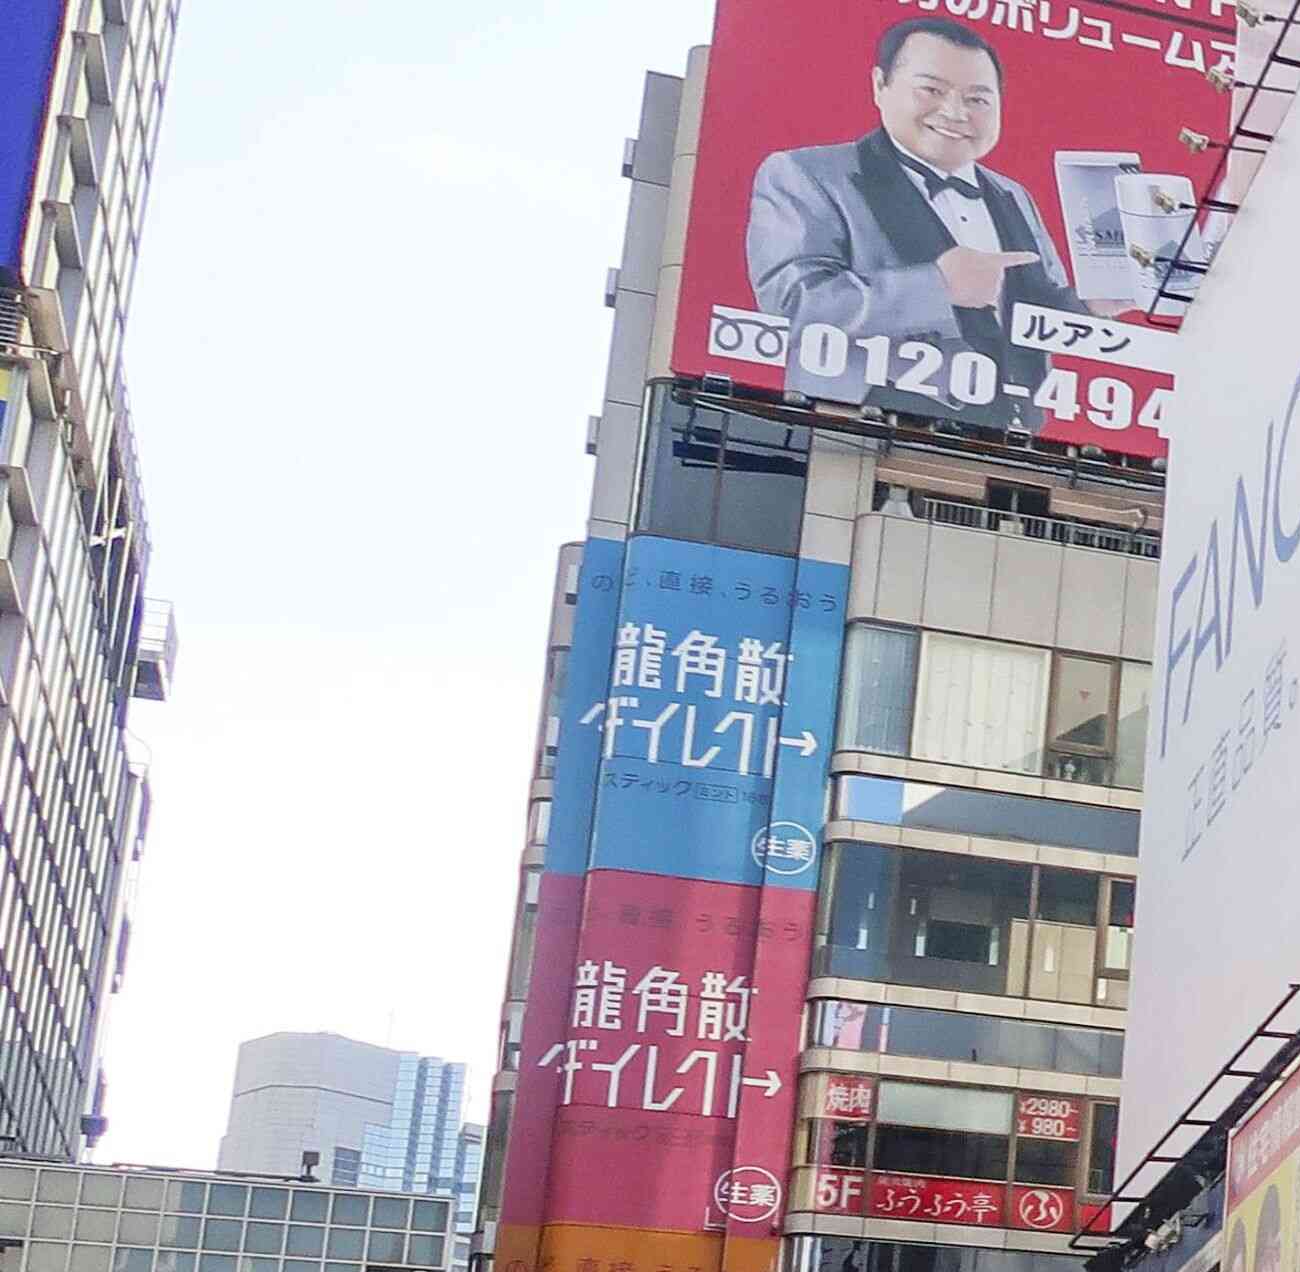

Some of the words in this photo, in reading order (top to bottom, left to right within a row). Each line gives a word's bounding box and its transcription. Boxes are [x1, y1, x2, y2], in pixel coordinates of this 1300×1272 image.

[1024, 313, 1131, 352] ルアン
[612, 622, 795, 708] 龍角散
[578, 696, 777, 779] ダイレクト
[572, 959, 760, 1043] 龍角散
[538, 1039, 743, 1119] ダイレクト
[720, 1181, 779, 1207] 生薬
[815, 1173, 864, 1209] 5F
